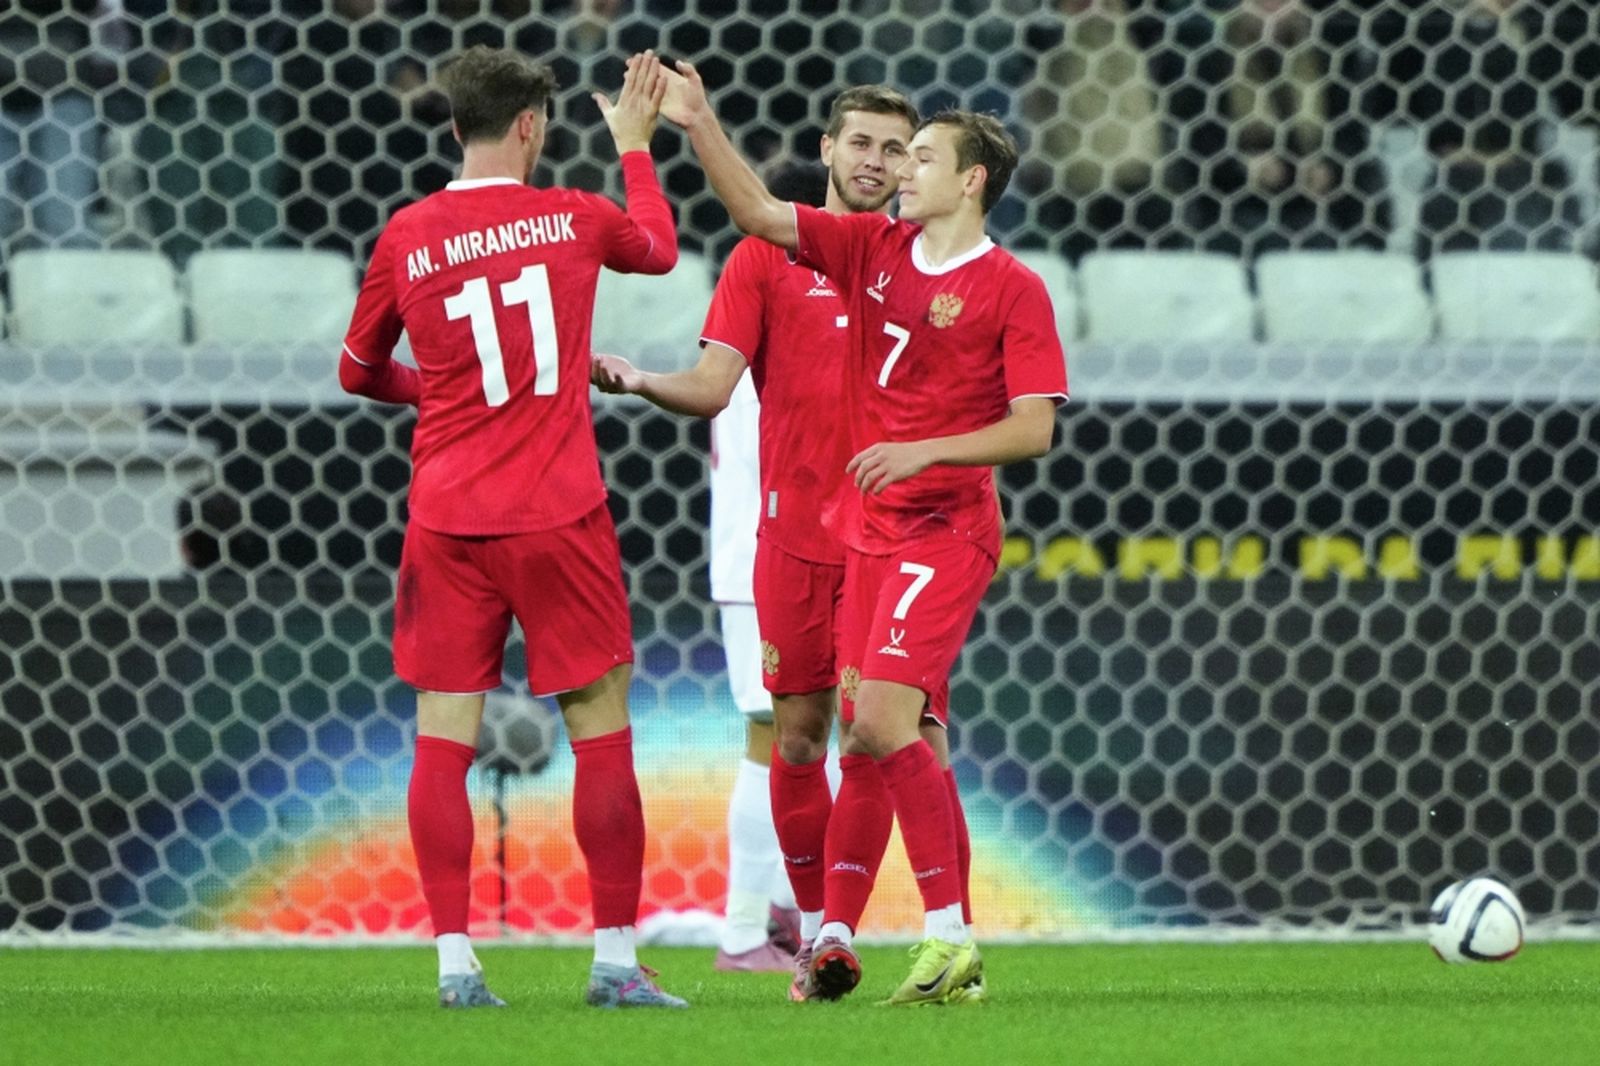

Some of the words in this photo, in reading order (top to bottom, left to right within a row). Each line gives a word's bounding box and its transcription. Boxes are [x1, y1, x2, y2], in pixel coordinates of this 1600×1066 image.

[407, 246, 441, 282] AN.
[443, 212, 577, 267] MIRANCHUK
[443, 263, 560, 408] 11
[877, 321, 911, 388] 7
[892, 561, 936, 620] 7
